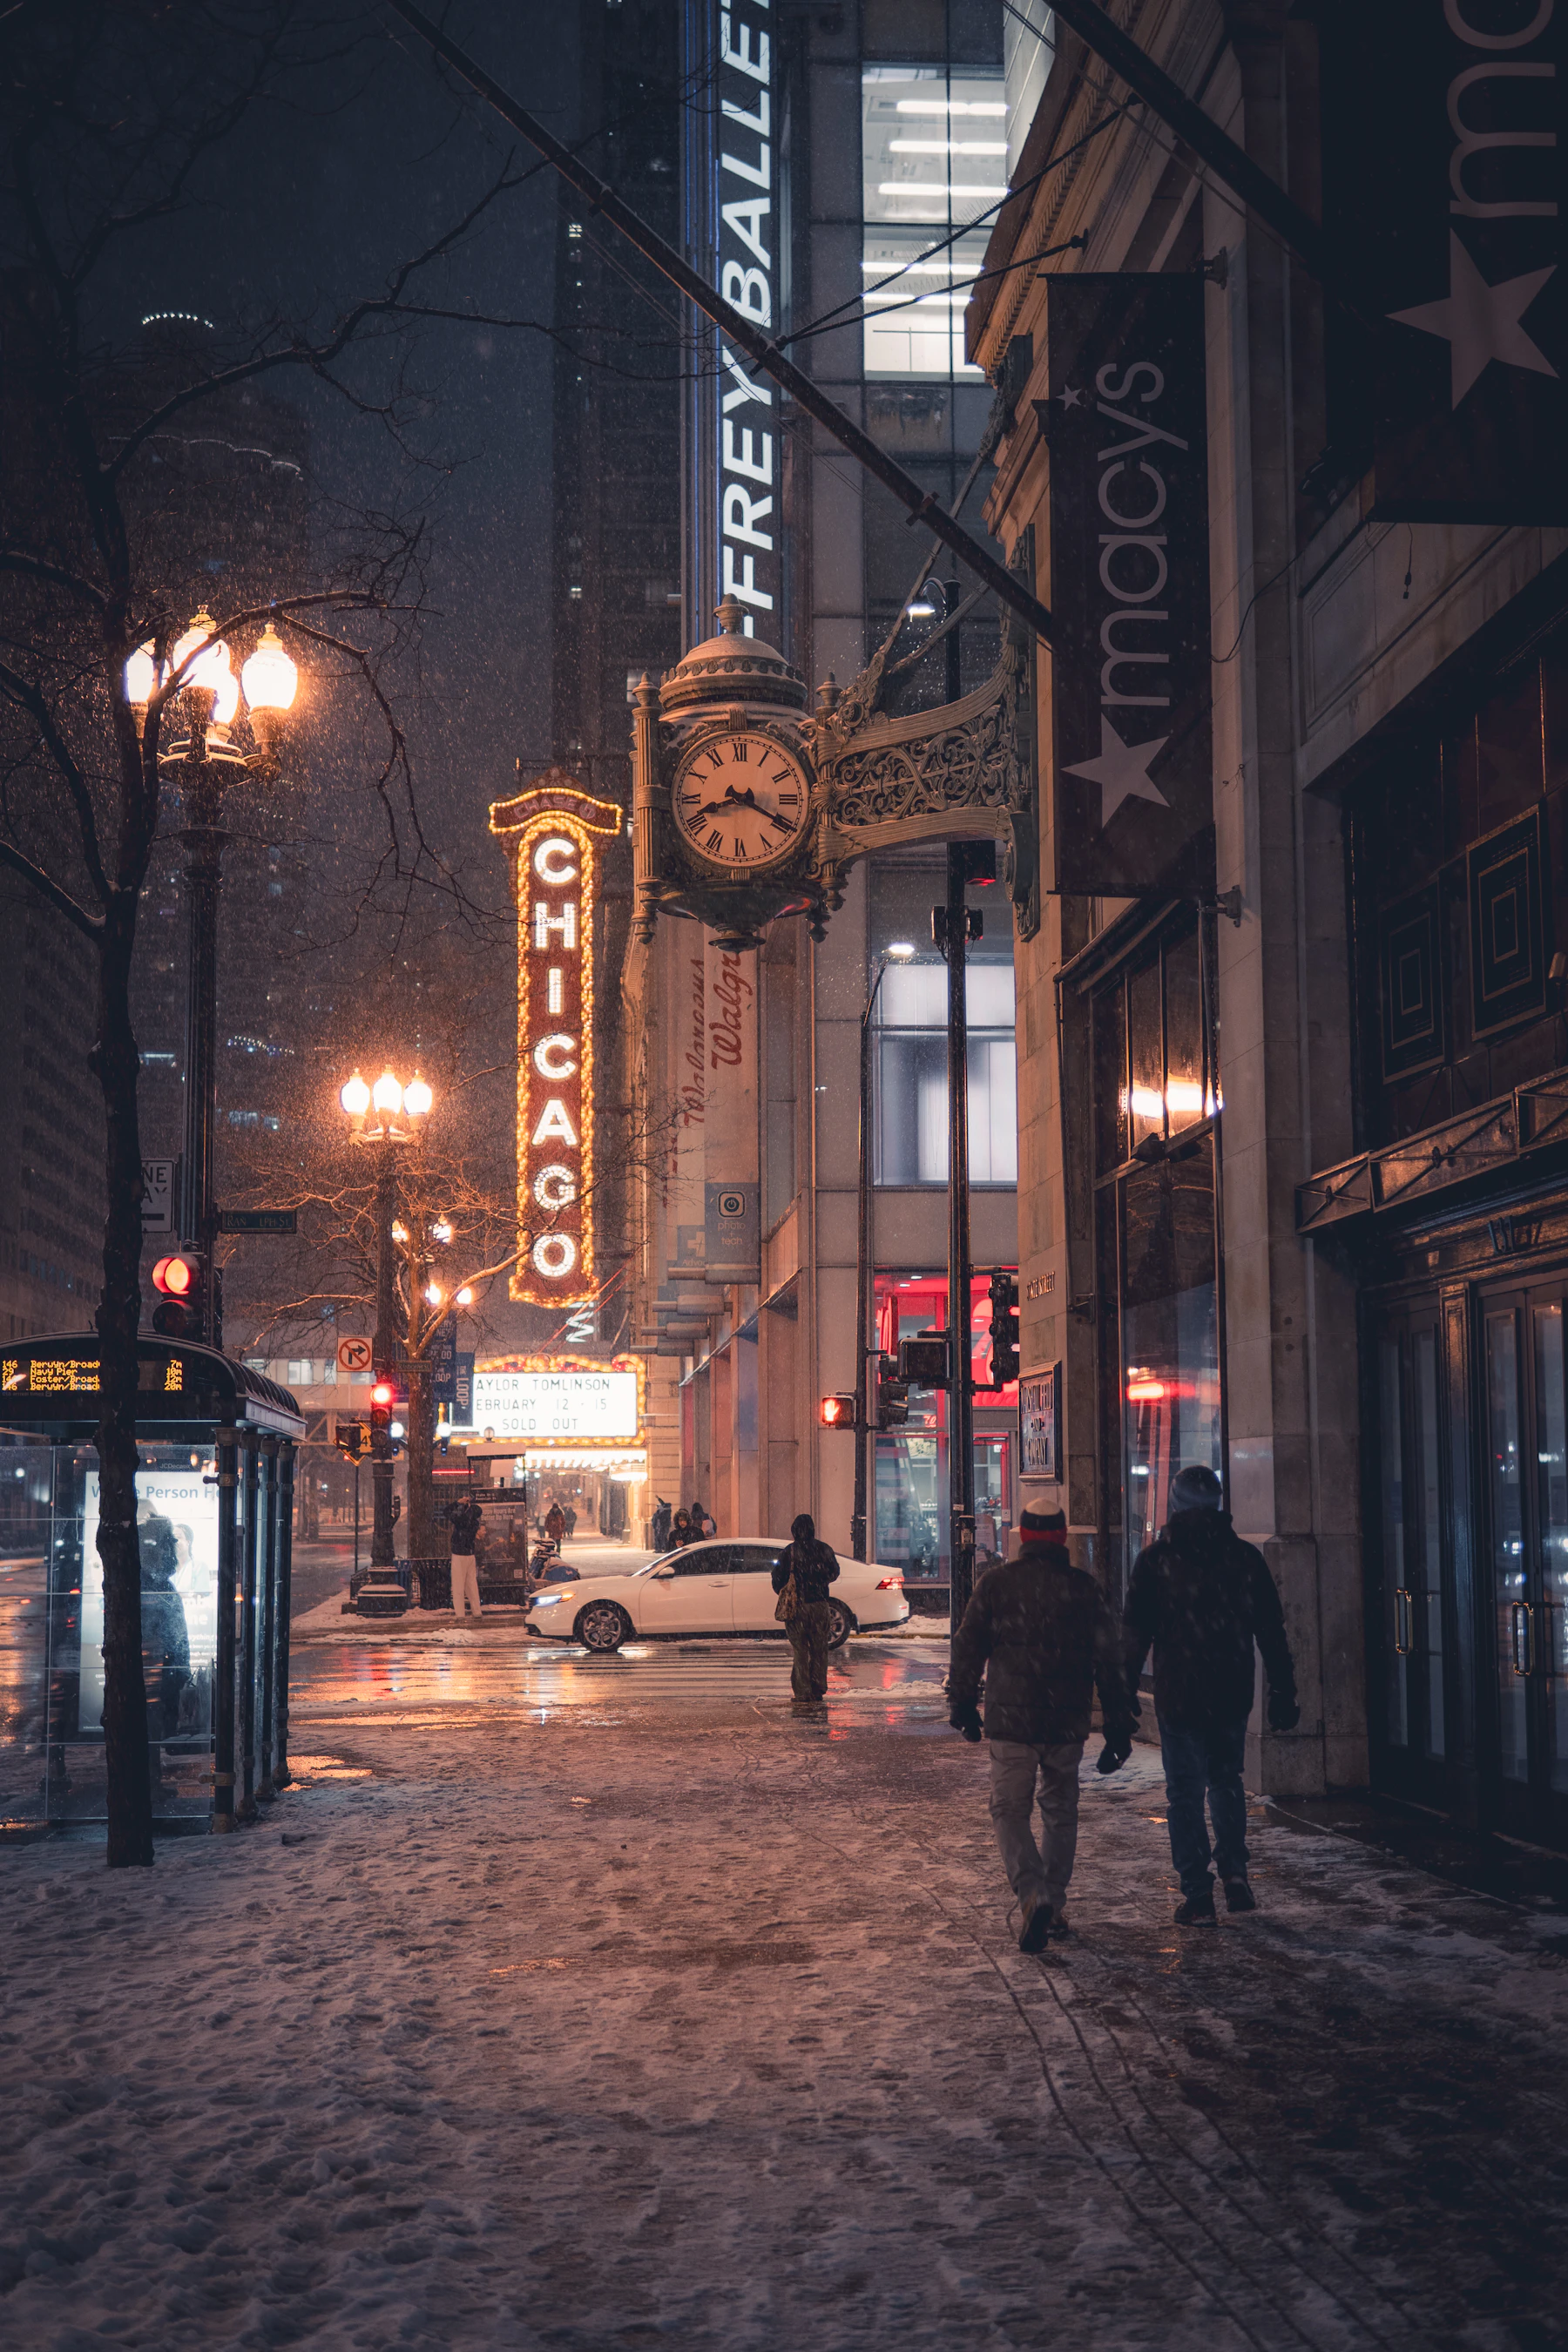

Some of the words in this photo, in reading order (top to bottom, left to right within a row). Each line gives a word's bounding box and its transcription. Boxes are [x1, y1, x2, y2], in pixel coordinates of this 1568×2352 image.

[721, 0, 772, 328] BALLE
[722, 344, 773, 639] FREY
[514, 795, 578, 819] CHASE
[531, 837, 578, 1279] CHICAGO
[141, 1167, 166, 1183] NE
[141, 1186, 167, 1204] AY
[226, 1214, 276, 1227] RANLPH
[718, 1220, 746, 1231] photo
[721, 1237, 743, 1246] tech
[1039, 1271, 1055, 1295] STREET
[436, 1373, 451, 1383] OOP
[476, 1379, 519, 1391] AYLOR
[532, 1379, 611, 1391] TOMLINSON
[456, 1377, 469, 1406] LOOP
[476, 1398, 537, 1410] EBRUARY
[556, 1398, 569, 1410] 12
[595, 1398, 607, 1410] 15
[503, 1418, 537, 1430] SOLD
[552, 1418, 578, 1430] OUT
[146, 1486, 199, 1498] Person
